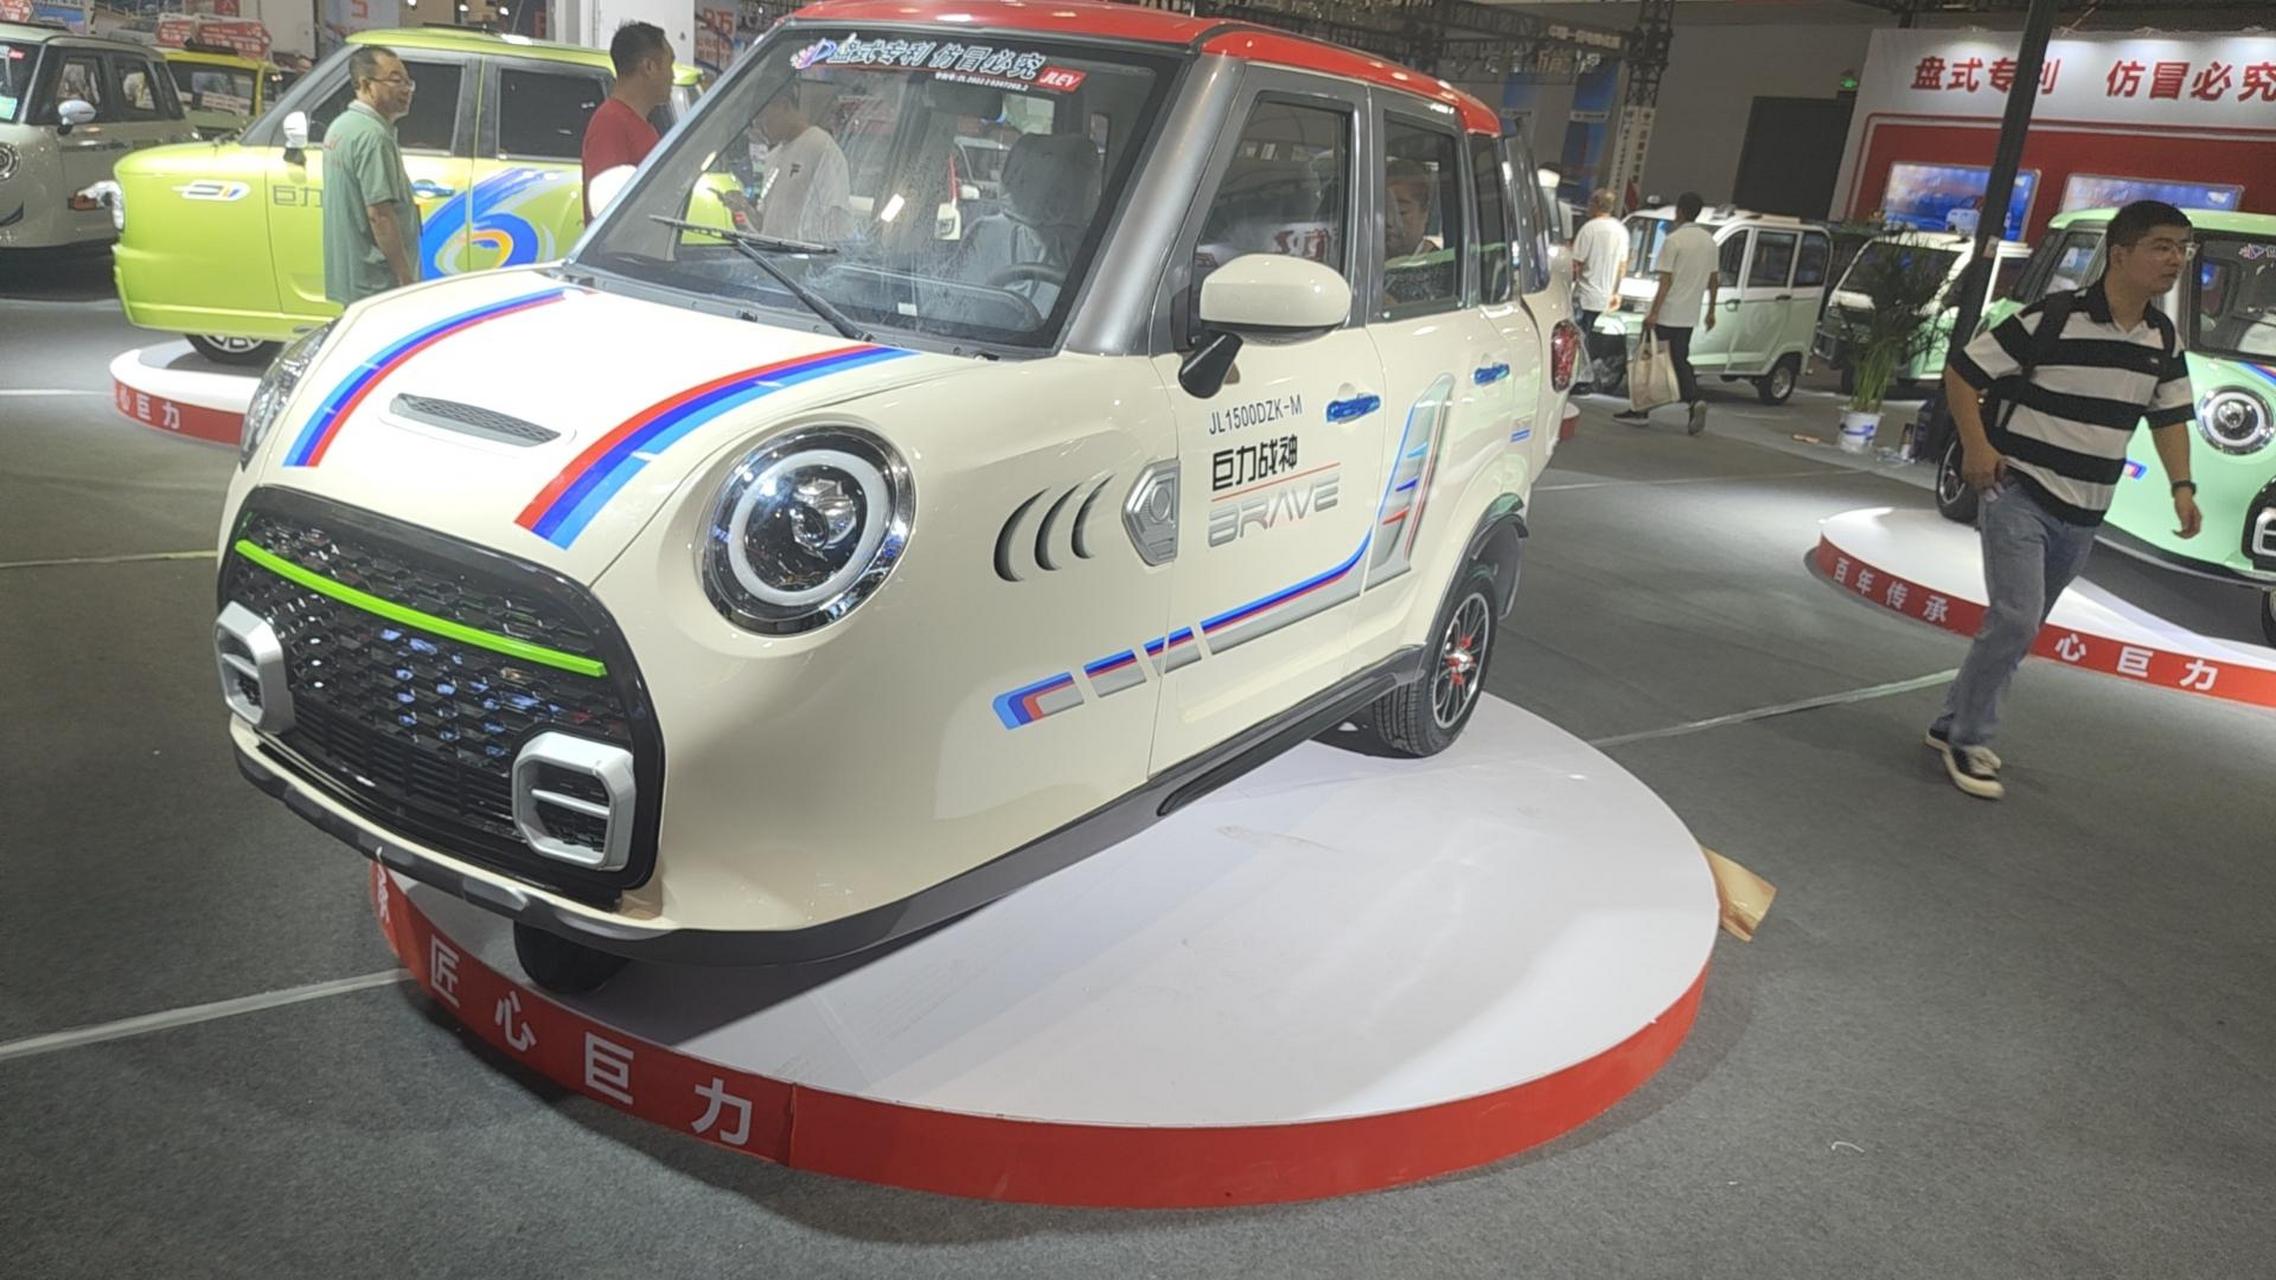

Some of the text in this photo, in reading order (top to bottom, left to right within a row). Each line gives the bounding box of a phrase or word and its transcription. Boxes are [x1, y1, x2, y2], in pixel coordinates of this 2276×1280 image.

[928, 42, 1046, 80] 仿冒必究
[1039, 71, 1081, 88] JLEV
[2106, 59, 2276, 102] 仿冒必究
[1209, 394, 1303, 435] JL1500DZK-M
[1212, 433, 1298, 491] 巨力战神
[1208, 474, 1340, 547] BRAVE
[1833, 556, 1949, 623] 百年传承
[430, 933, 753, 1147] 匠心巨力
